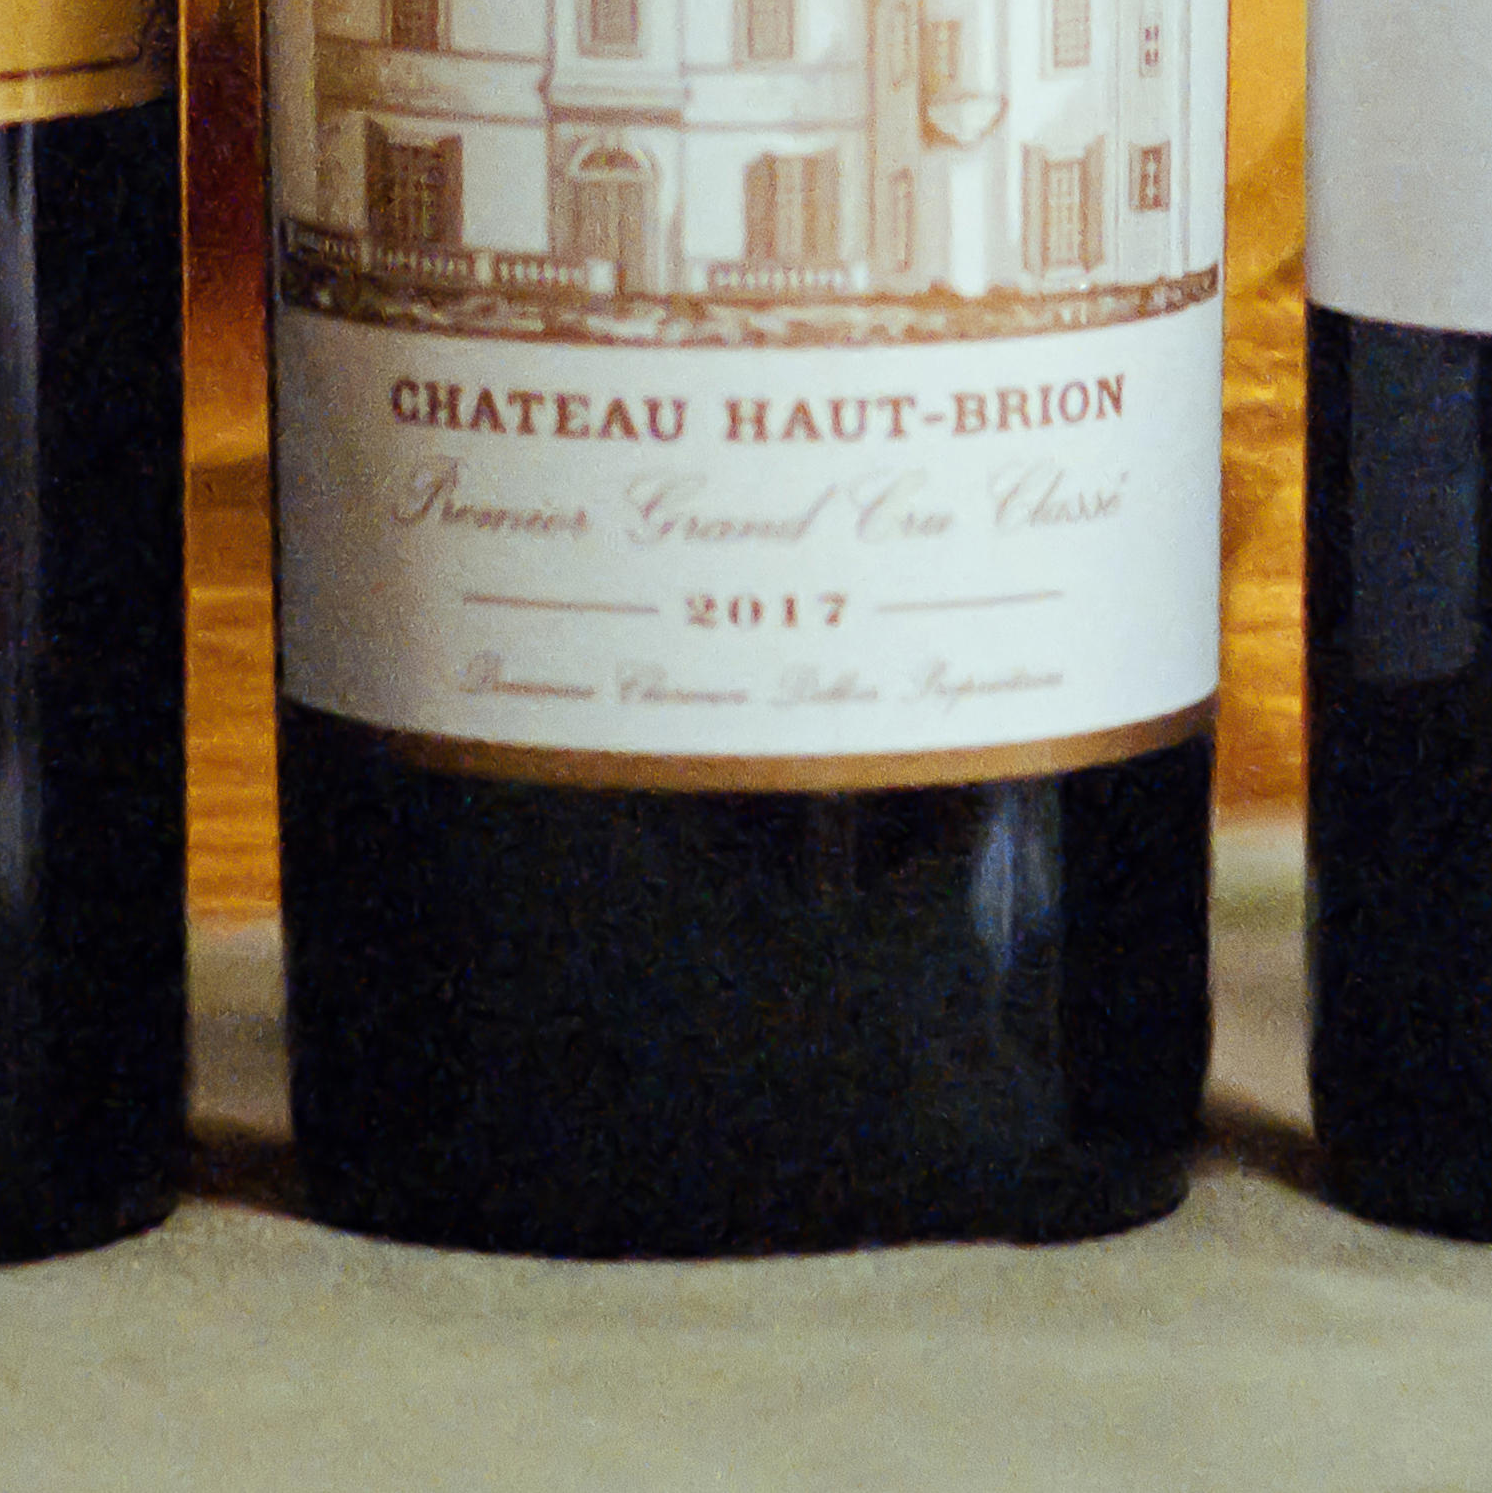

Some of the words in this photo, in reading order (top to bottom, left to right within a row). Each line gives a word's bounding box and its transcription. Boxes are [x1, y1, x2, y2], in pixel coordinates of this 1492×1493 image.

[389, 376, 689, 443] CHATEAU
[722, 373, 1129, 444] HAUT-BRION
[685, 593, 849, 629] 2017
